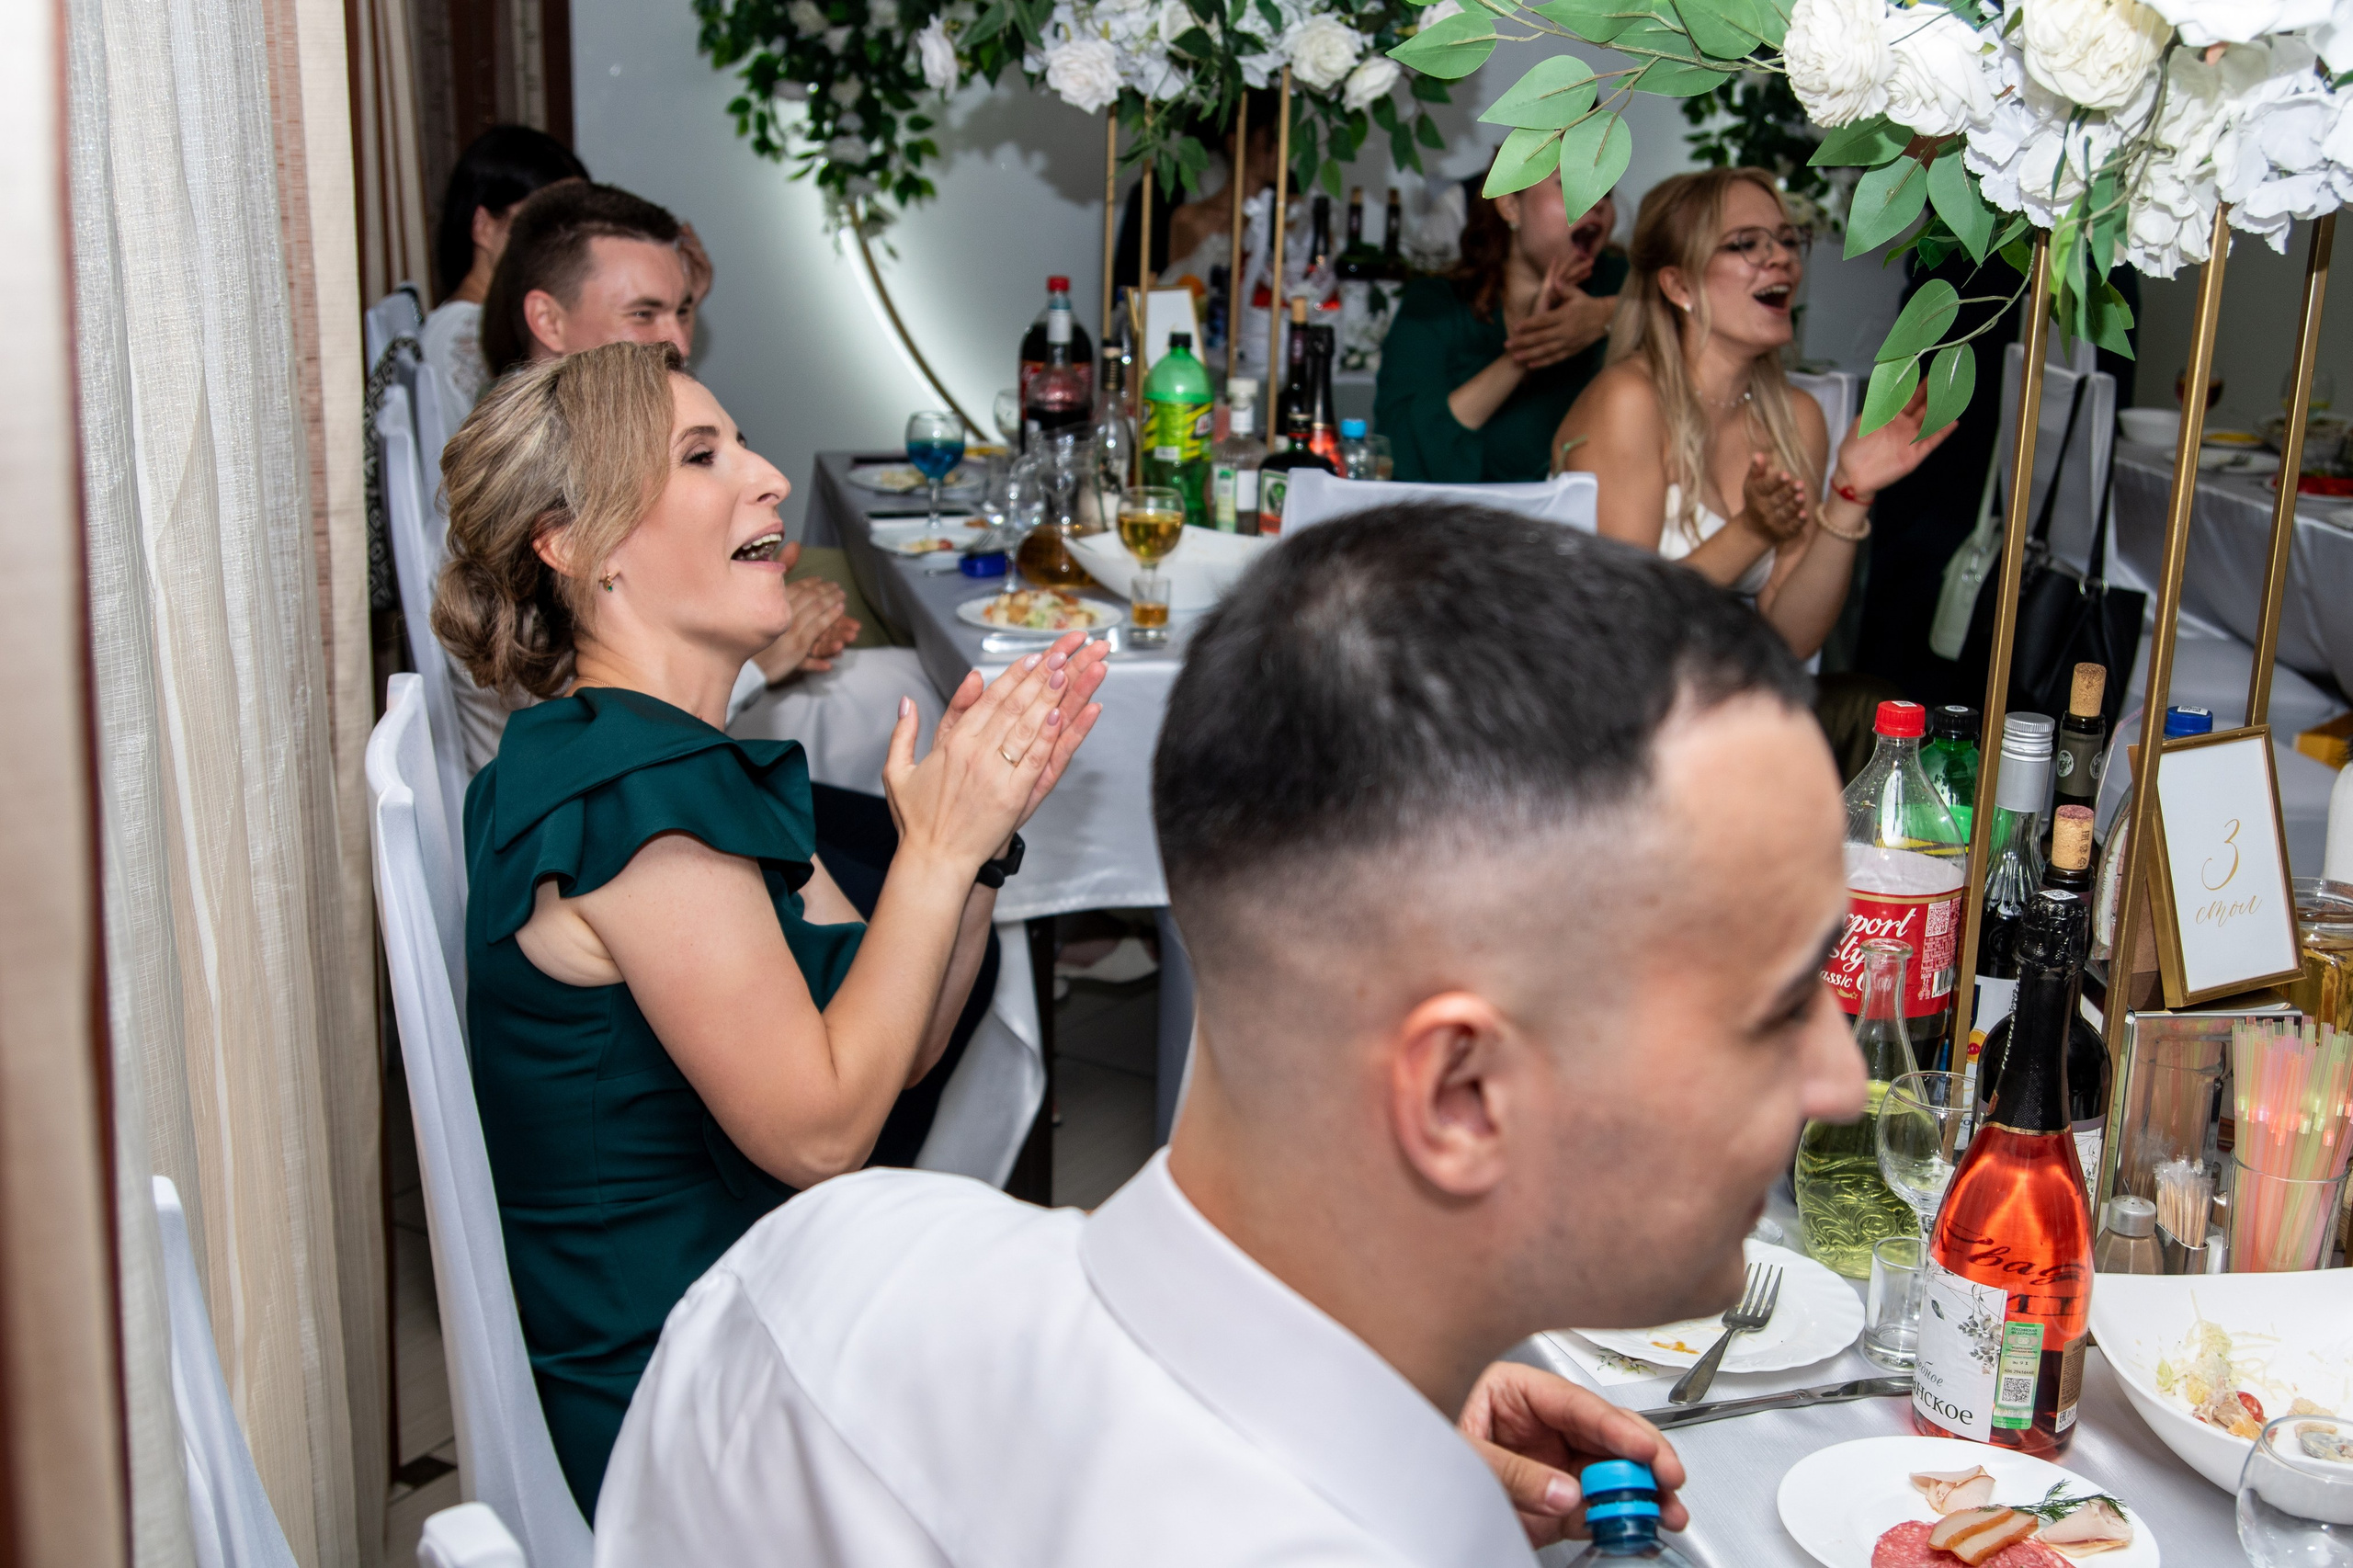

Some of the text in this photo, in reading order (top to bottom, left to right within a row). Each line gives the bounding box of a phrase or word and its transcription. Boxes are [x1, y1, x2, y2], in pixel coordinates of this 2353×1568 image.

[2201, 818, 2240, 891] 3
[1839, 907, 1916, 945] port
[1819, 970, 1852, 988] assic
[1912, 1379, 1973, 1426] анское
